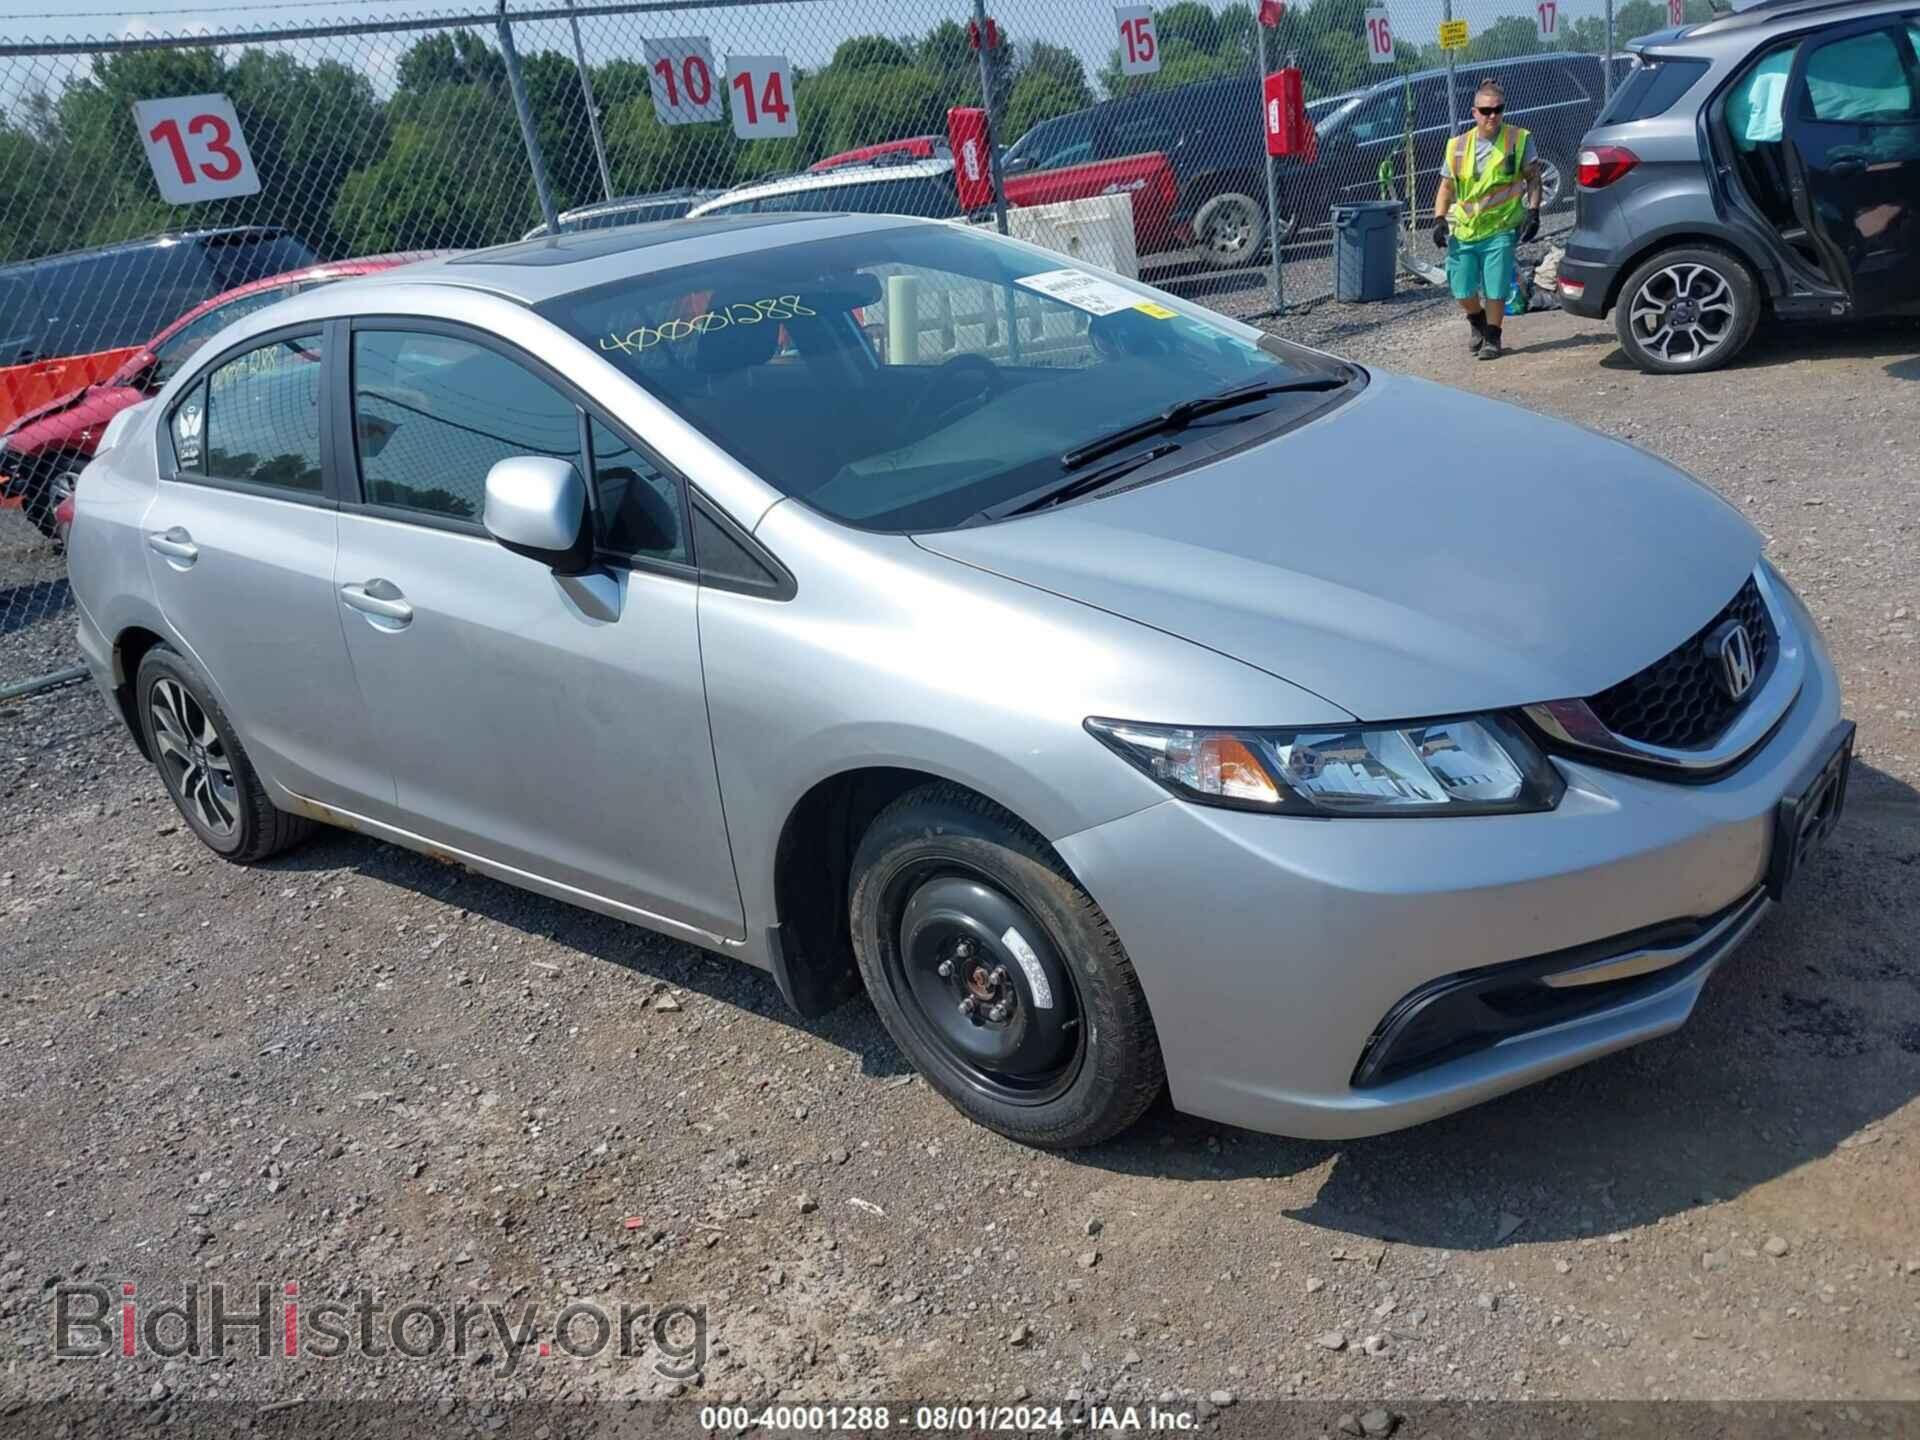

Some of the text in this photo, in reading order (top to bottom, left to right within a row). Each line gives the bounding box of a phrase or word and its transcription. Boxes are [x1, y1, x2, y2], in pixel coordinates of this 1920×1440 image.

[1368, 17, 1391, 54] 16
[1538, 2, 1556, 34] 17
[1668, 0, 1682, 26] 18
[1120, 17, 1154, 64] 15
[655, 54, 712, 107] 10
[733, 71, 790, 124] 14
[149, 114, 243, 185] 13
[600, 295, 816, 355] 40001288
